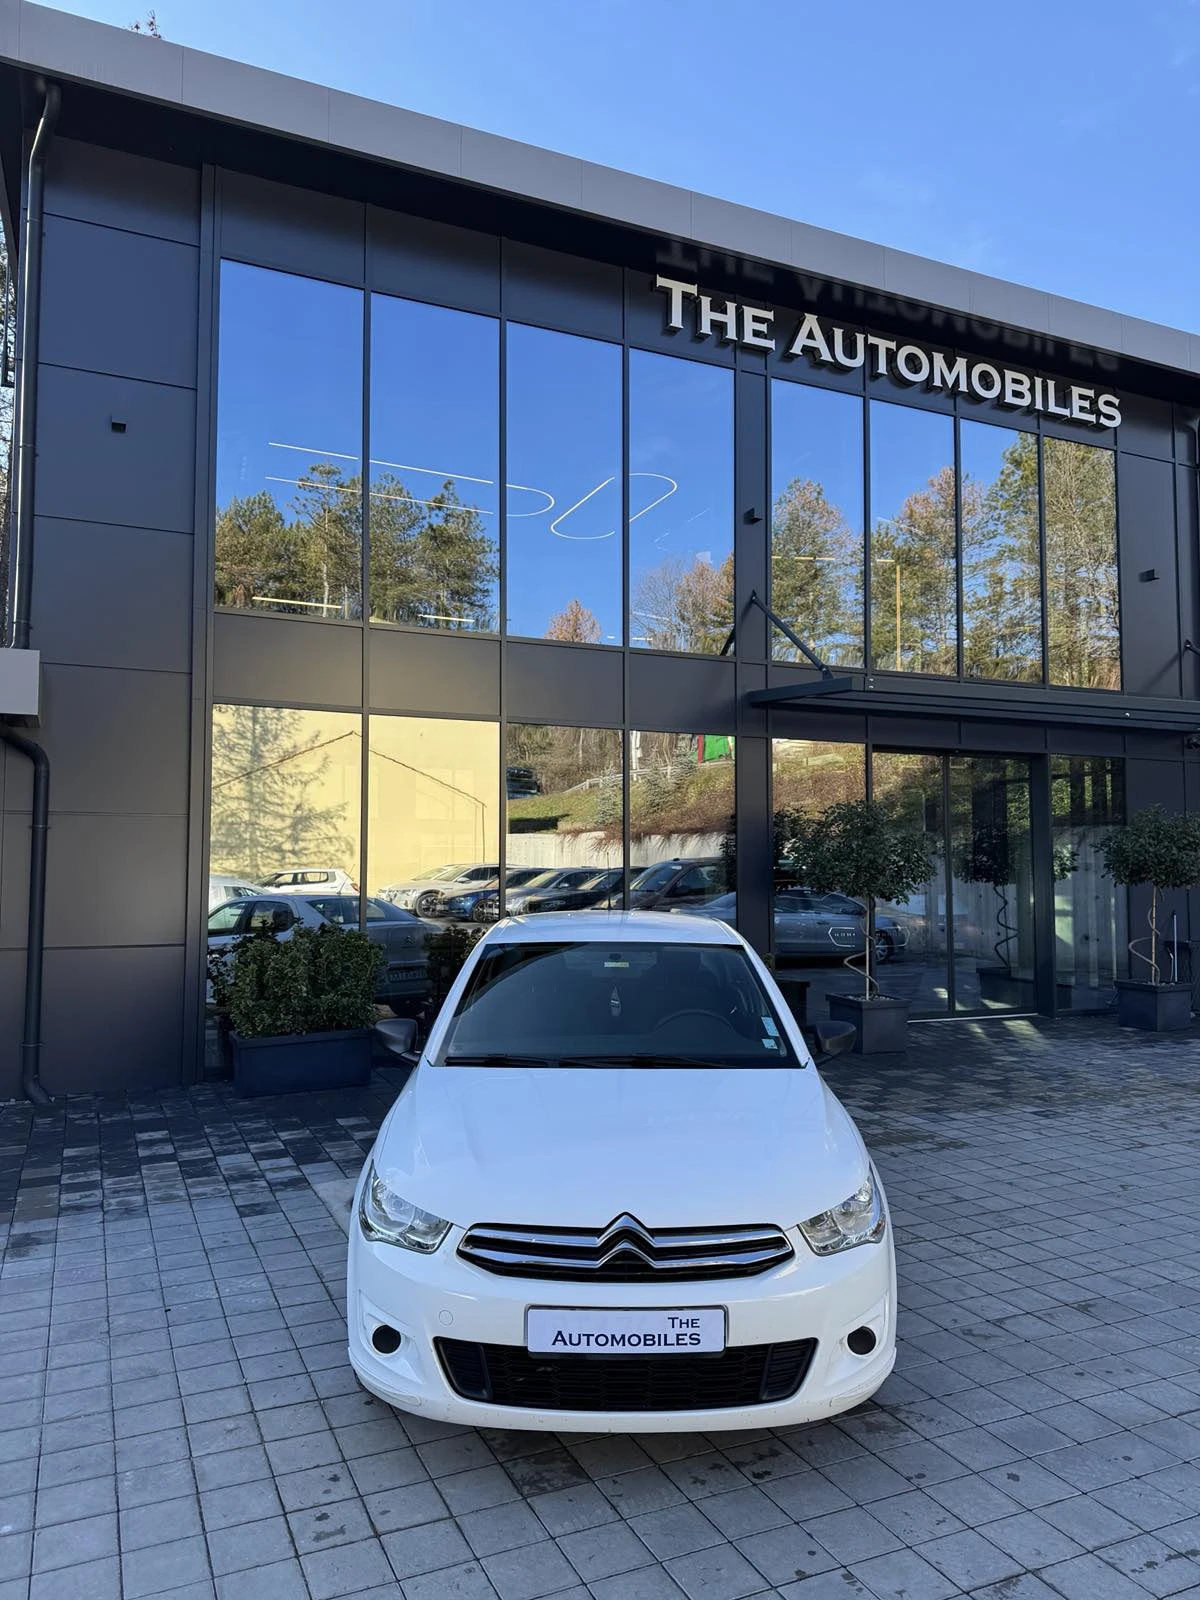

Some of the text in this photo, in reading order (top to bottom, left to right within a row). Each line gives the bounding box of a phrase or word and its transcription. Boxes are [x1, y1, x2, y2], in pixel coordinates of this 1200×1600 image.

[656, 275, 776, 351] THE
[789, 313, 1122, 428] AUTOMOBILES
[668, 1316, 700, 1329] THE
[552, 1330, 701, 1347] AUTOMOBILES
